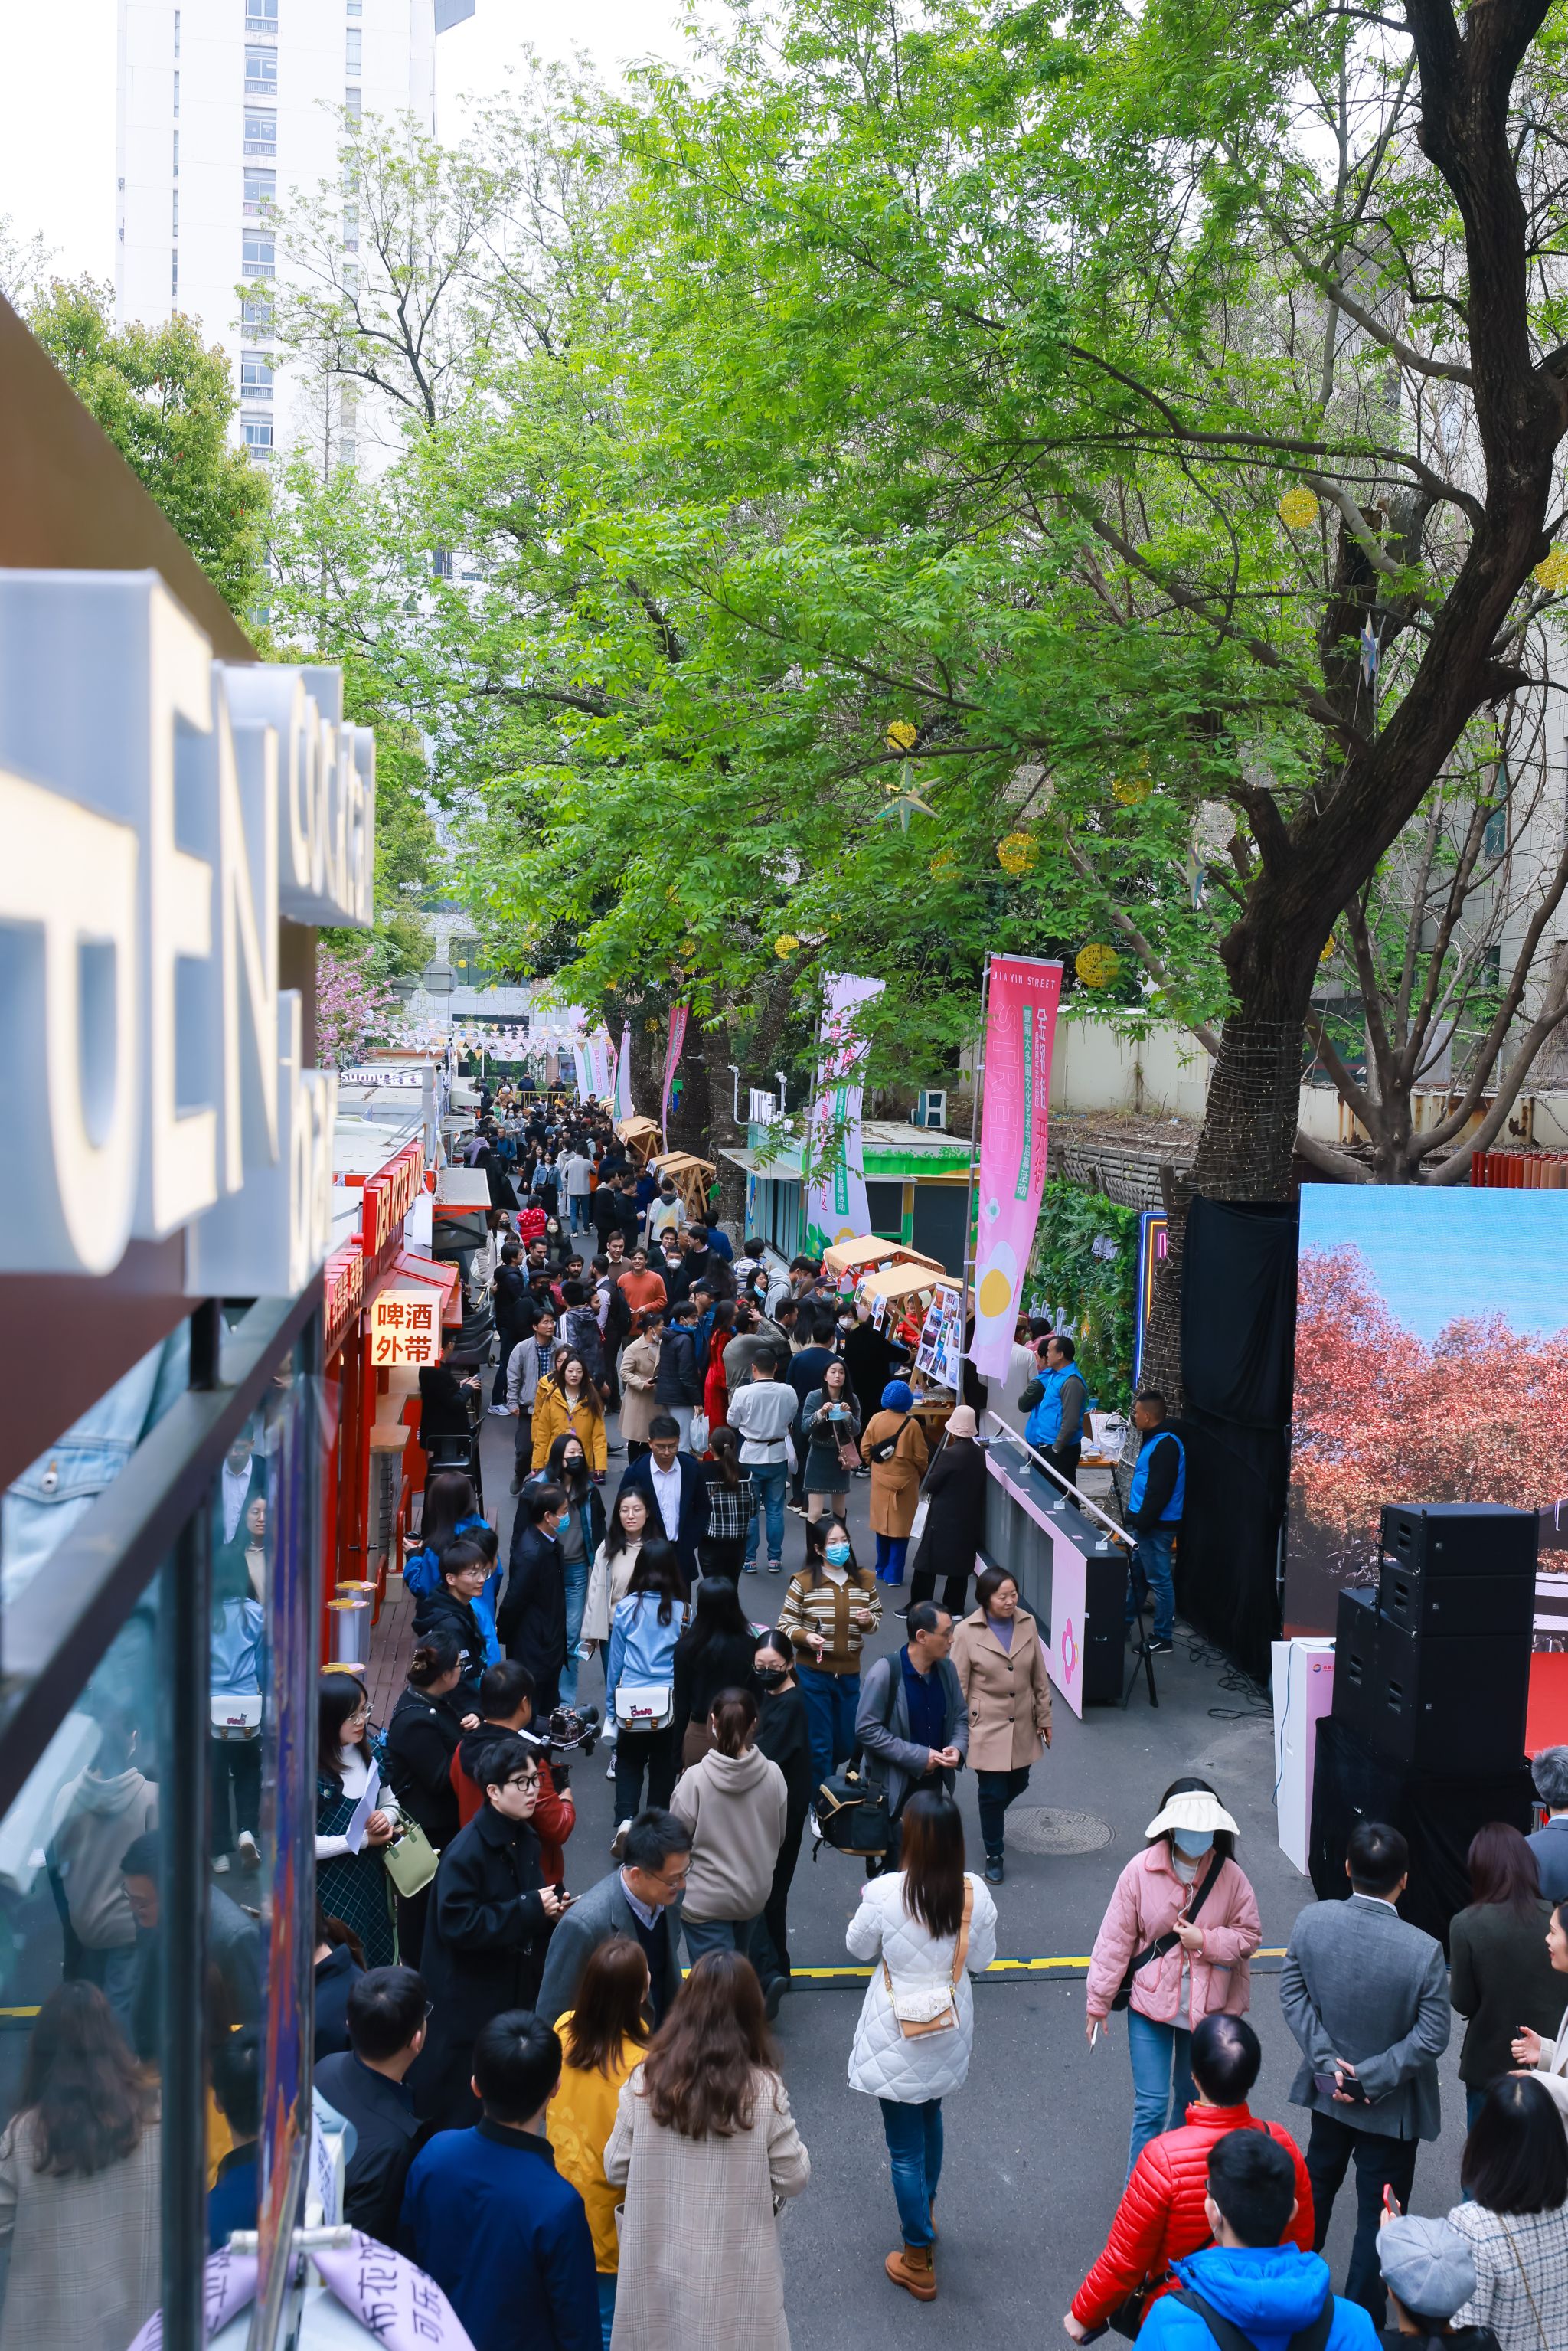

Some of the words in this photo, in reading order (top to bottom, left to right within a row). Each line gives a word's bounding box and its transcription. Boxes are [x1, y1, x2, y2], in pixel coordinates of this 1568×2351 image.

[992, 971, 1008, 982] JIN
[1010, 973, 1023, 984] YIN
[1027, 976, 1056, 989] STREET
[377, 1303, 433, 1330] 啤酒
[376, 1336, 432, 1363] 外带
